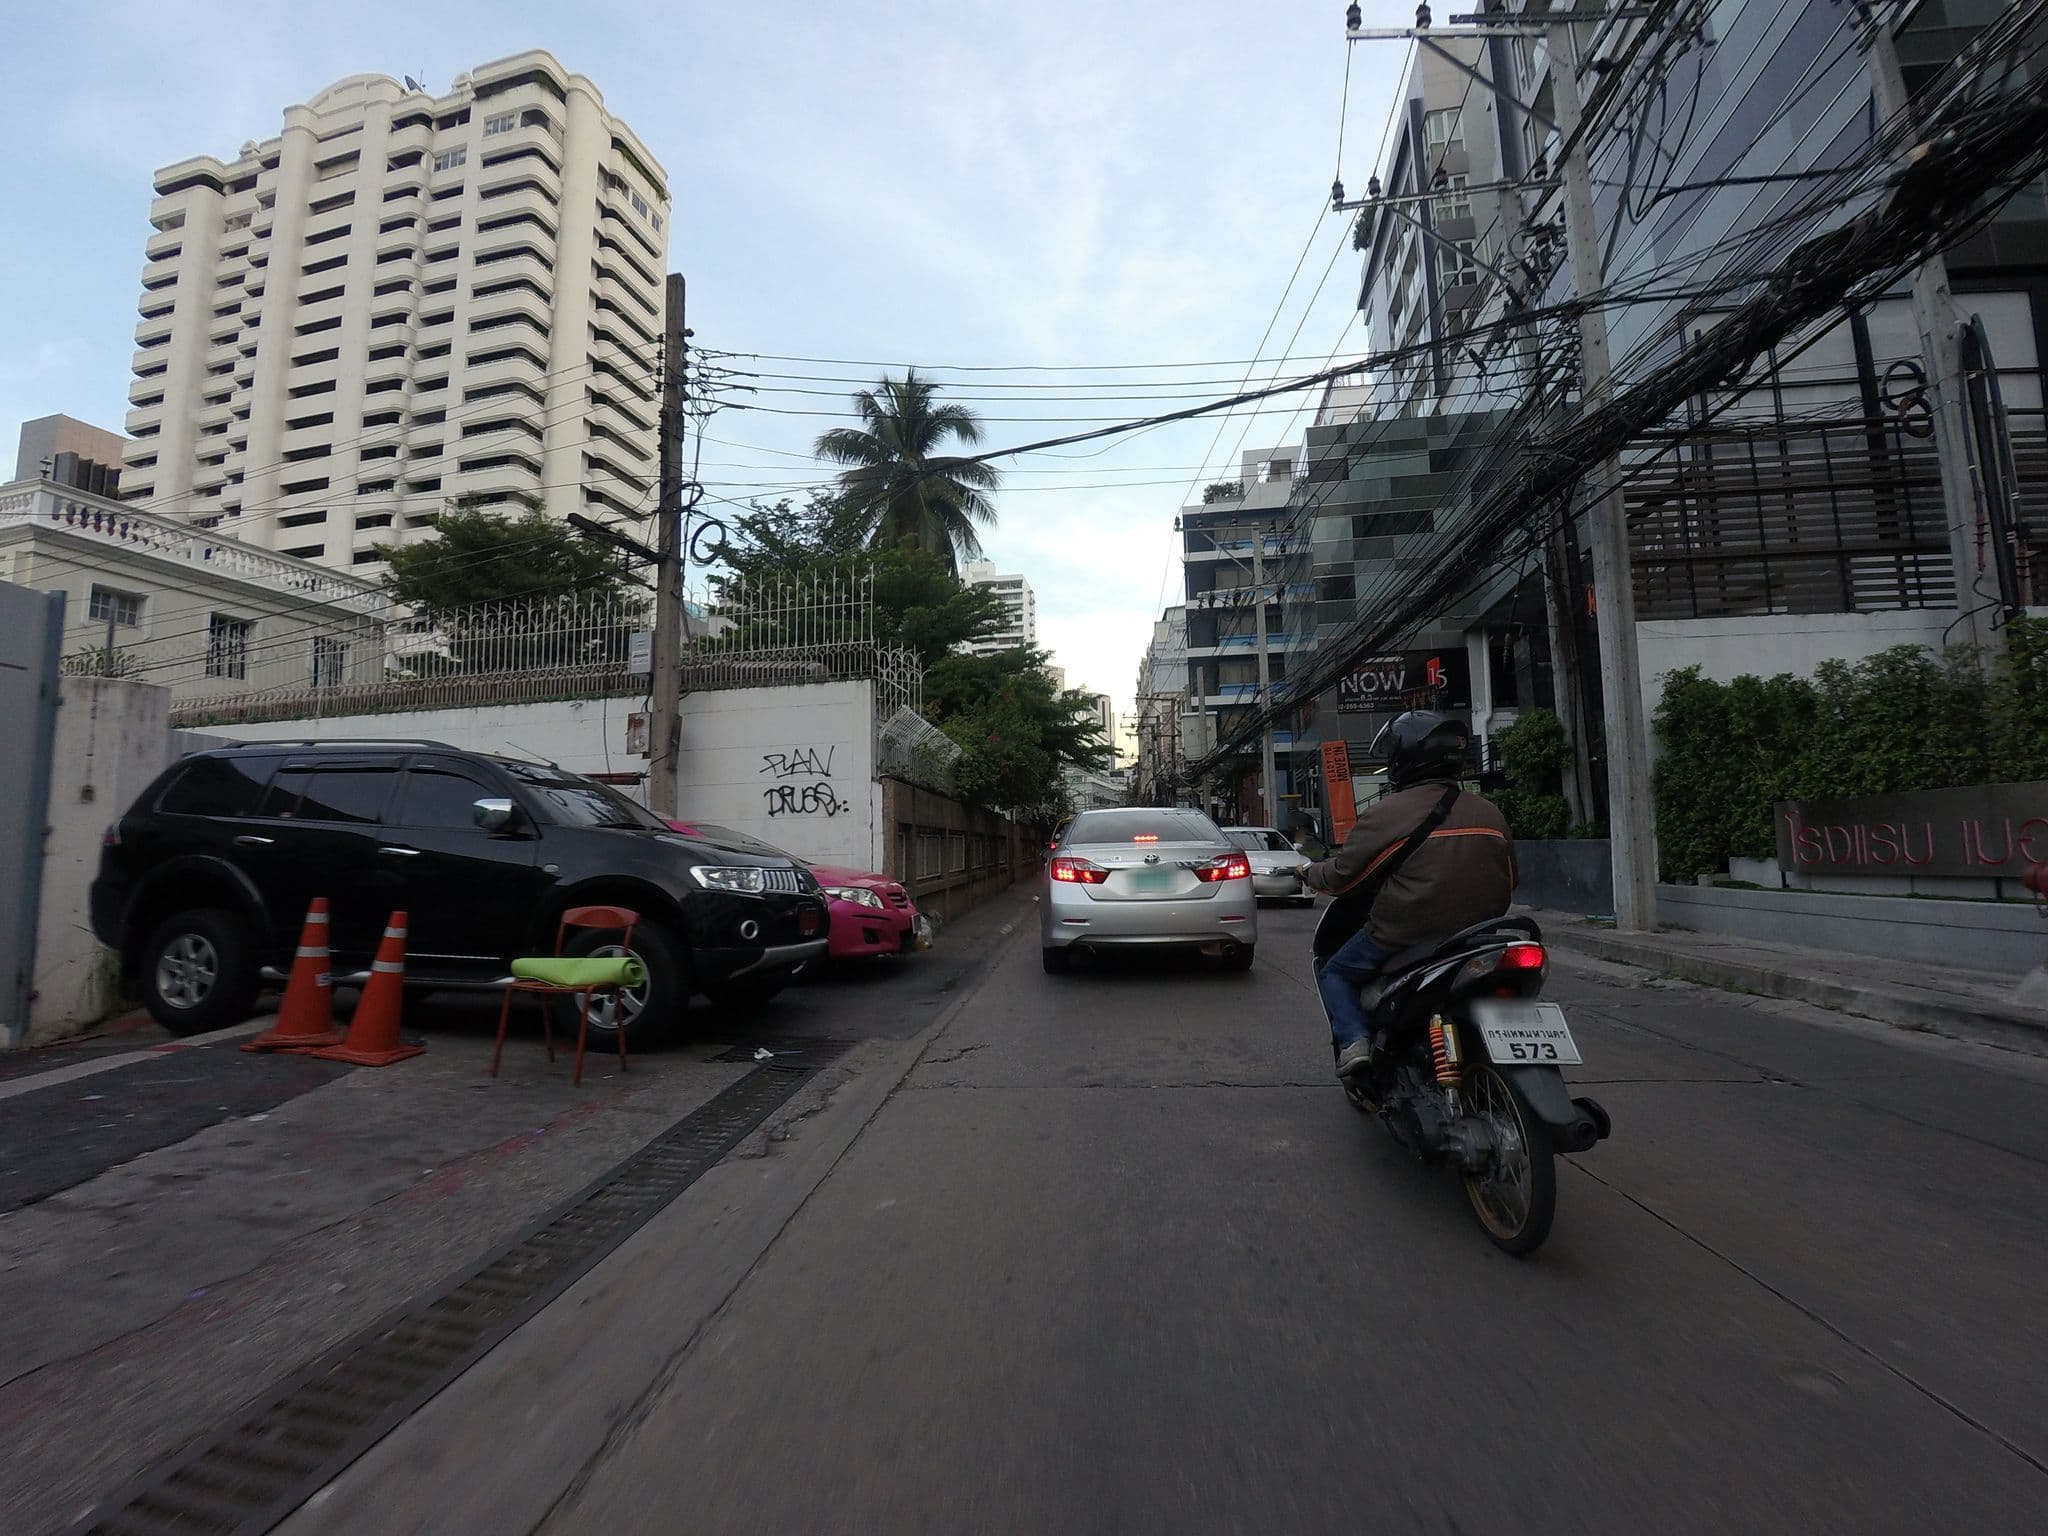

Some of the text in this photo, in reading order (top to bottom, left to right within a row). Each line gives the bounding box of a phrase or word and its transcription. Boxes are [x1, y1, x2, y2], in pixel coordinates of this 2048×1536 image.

[1340, 670, 1406, 694] NOW
[1429, 668, 1448, 689] 15
[1332, 746, 1349, 782] MOVE IN
[1488, 1029, 1567, 1042] กรุงเทพมหานคร
[1509, 1043, 1558, 1059] 573
